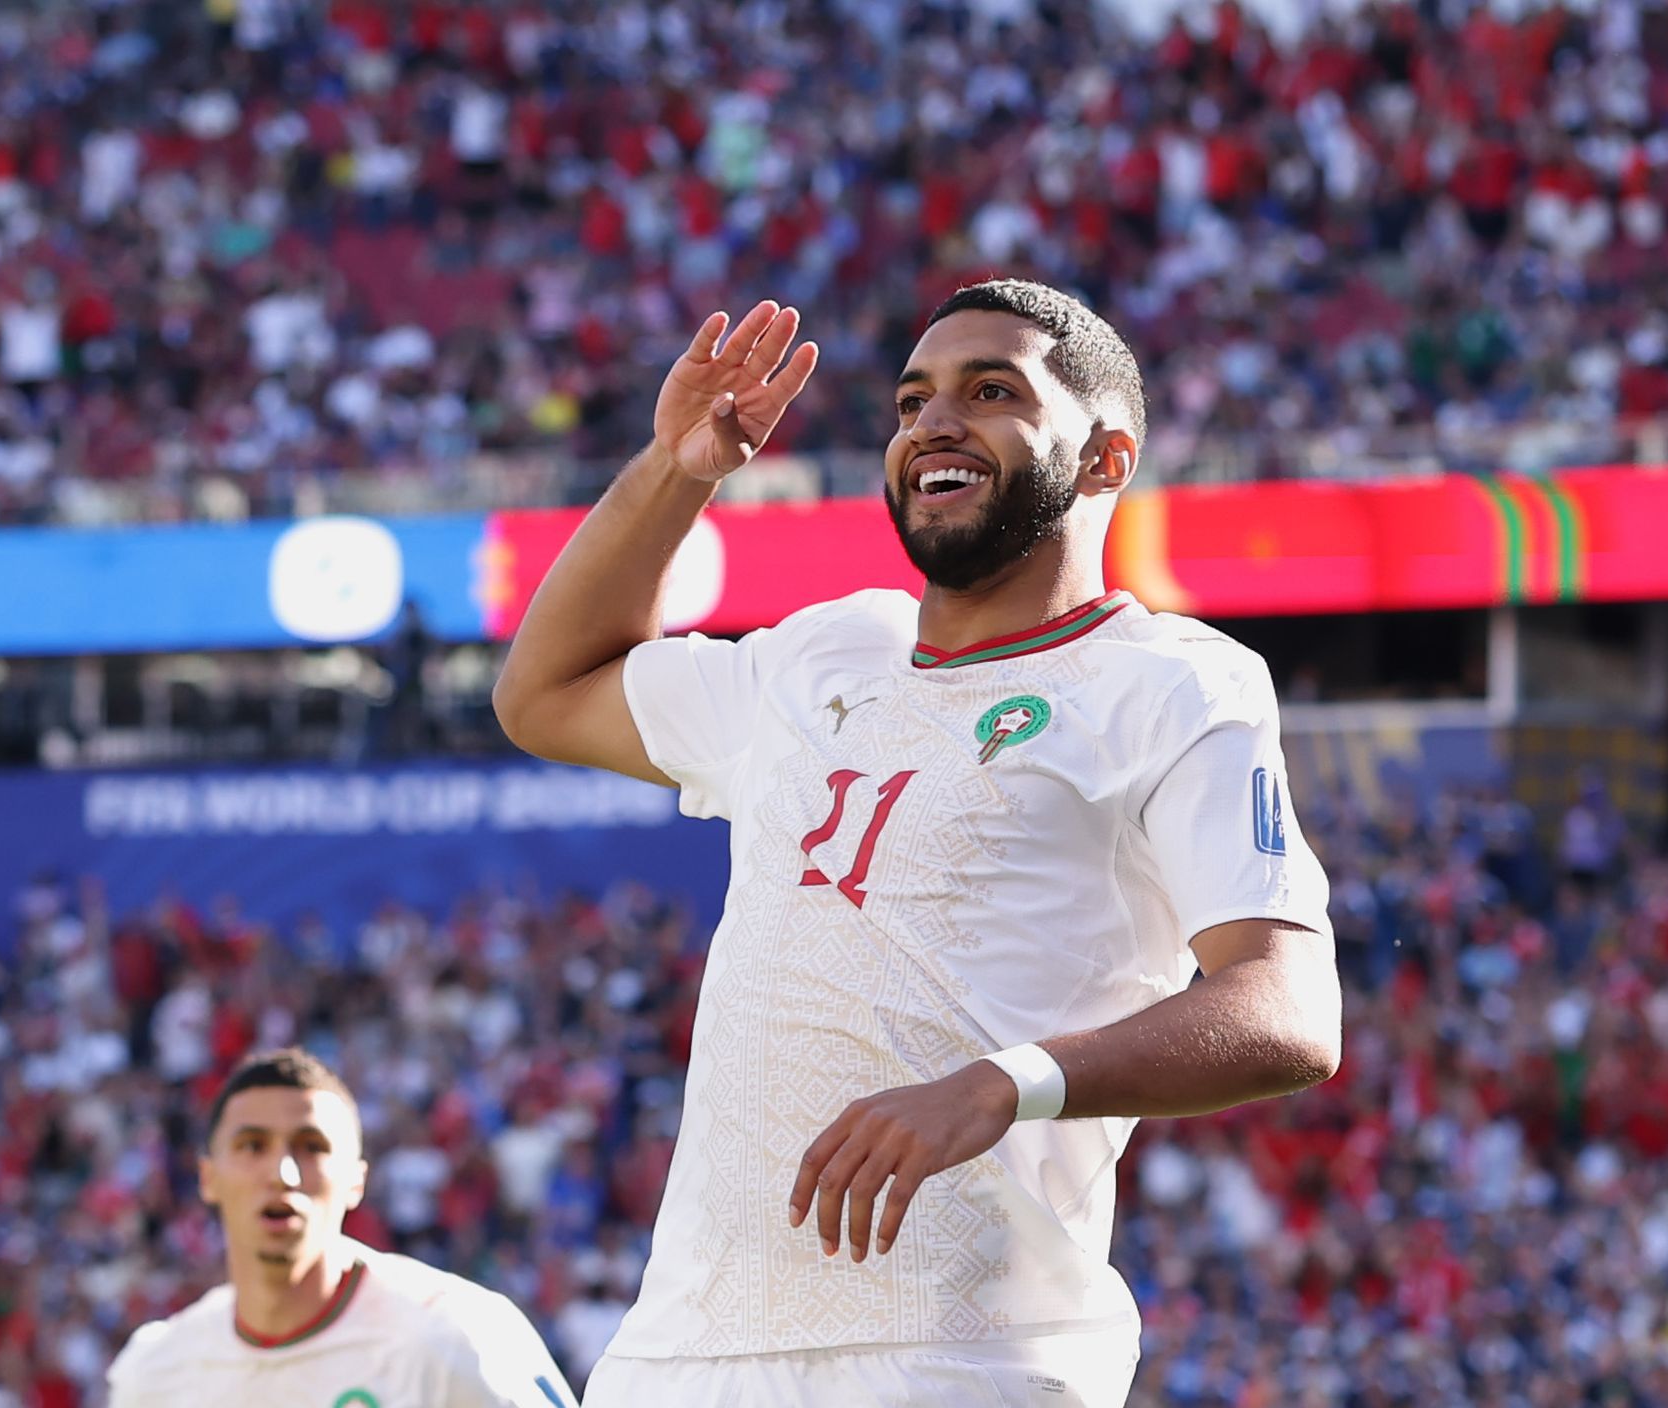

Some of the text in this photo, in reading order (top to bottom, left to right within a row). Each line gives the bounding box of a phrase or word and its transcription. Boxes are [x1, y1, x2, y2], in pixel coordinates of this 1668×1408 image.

[85, 777, 191, 836] FIFA
[204, 775, 377, 834] WORLD
[389, 774, 482, 832] CUP
